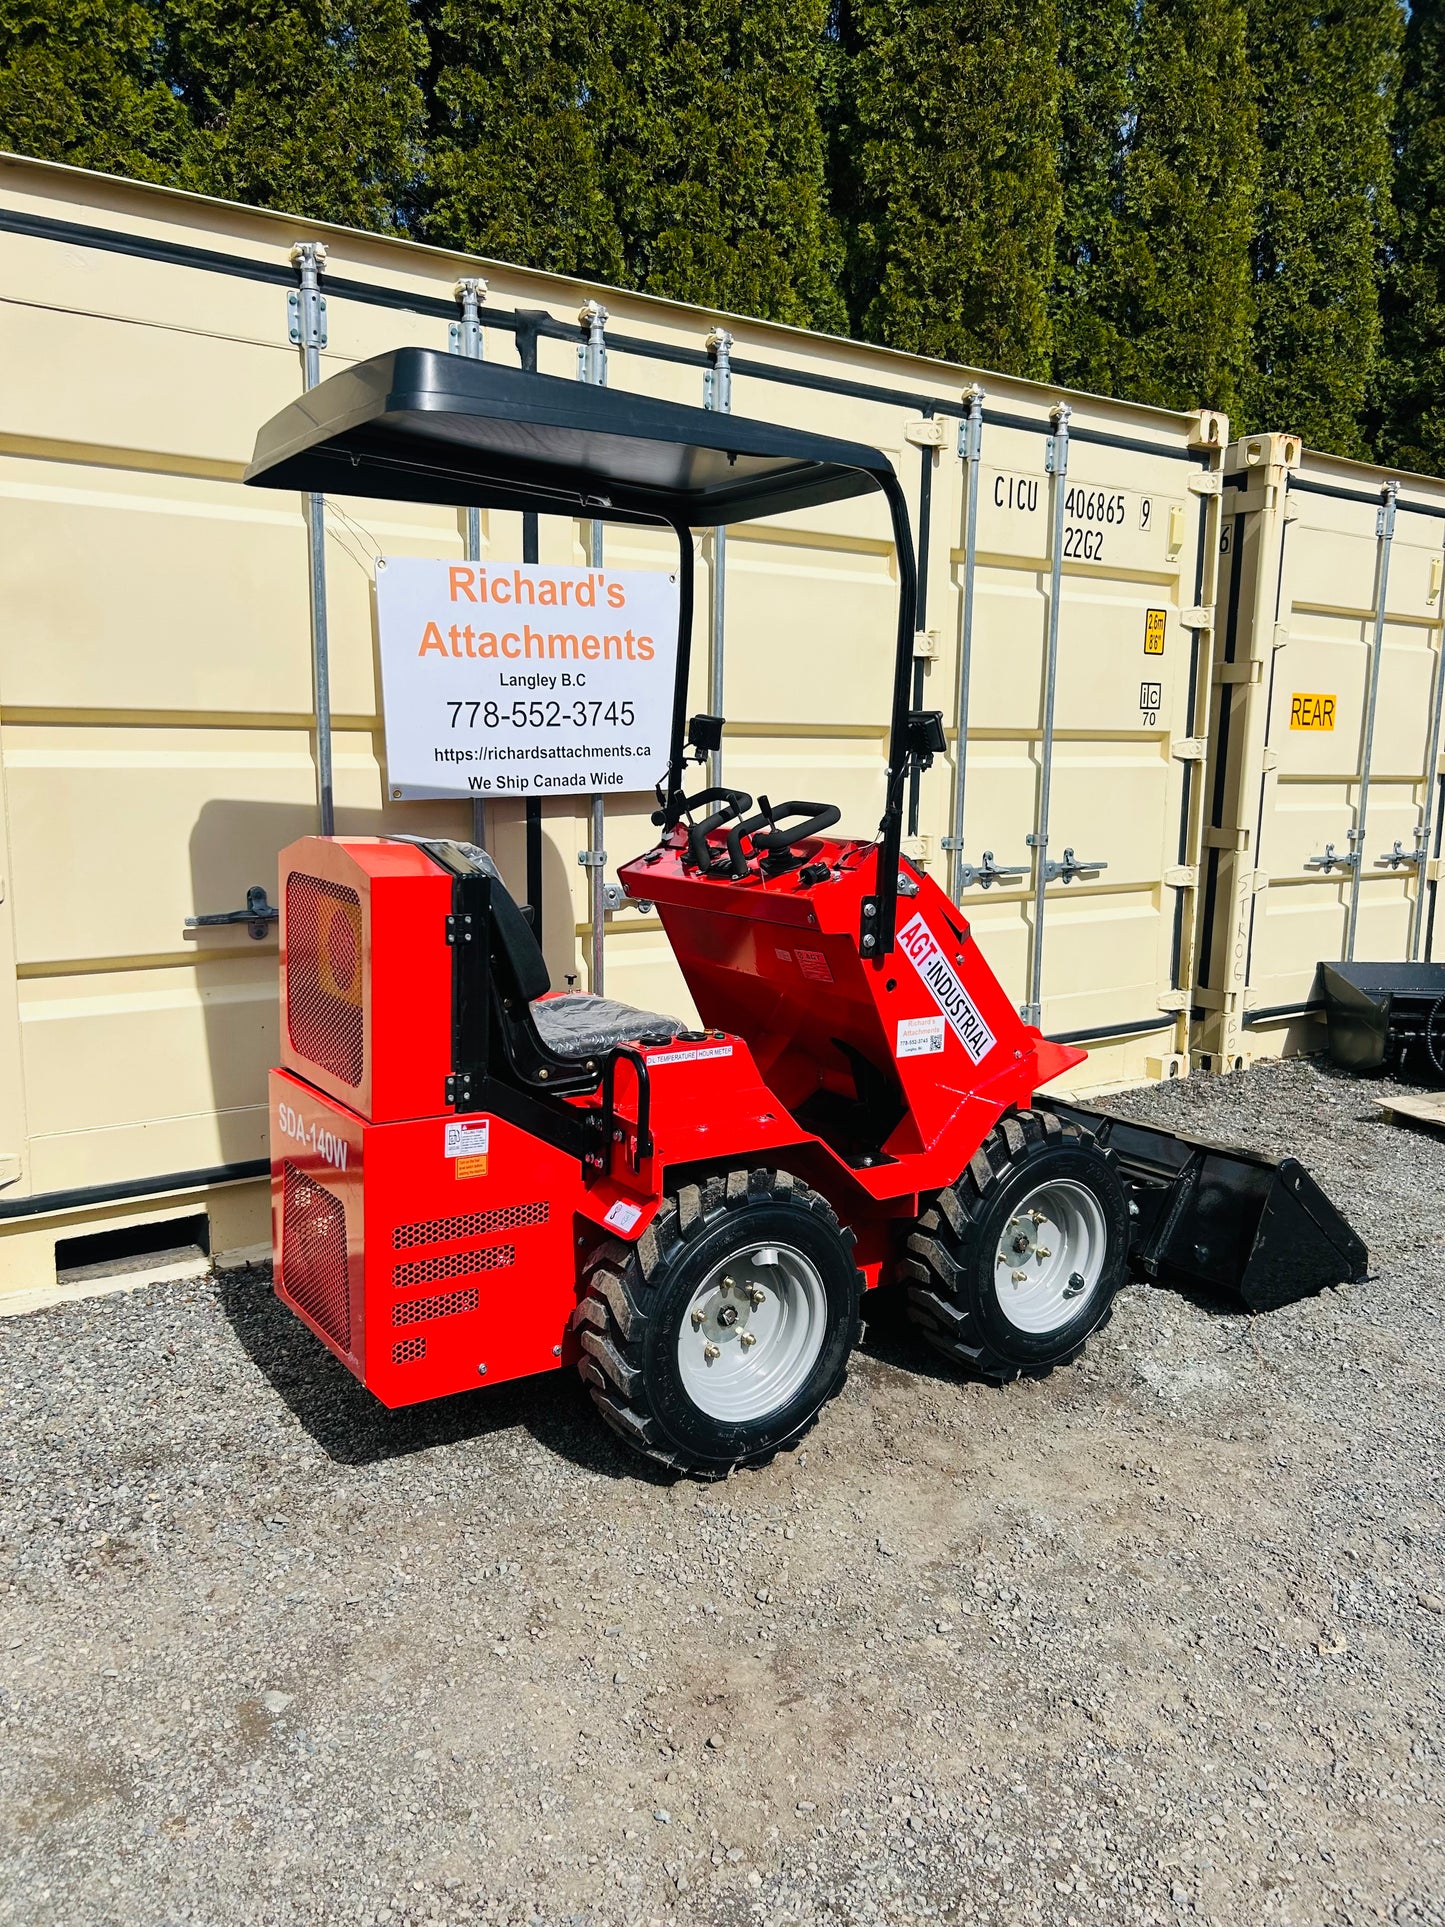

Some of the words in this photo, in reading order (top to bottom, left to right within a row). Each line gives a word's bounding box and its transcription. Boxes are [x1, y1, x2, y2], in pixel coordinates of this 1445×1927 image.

[994, 475, 1038, 512] CICU
[1065, 487, 1125, 525] 406865
[1142, 499, 1151, 528] 9
[1064, 527, 1104, 561] 22G2
[1219, 526, 1229, 552] 6
[449, 566, 626, 609] Richard's
[418, 621, 656, 661] Attachments
[499, 672, 557, 690] Langley
[562, 673, 586, 687] B.C
[447, 700, 635, 728] 778-552-3745
[1142, 711, 1156, 726] 70
[1290, 698, 1335, 727] REAR
[434, 744, 651, 765] https://richardsattachments.ca
[468, 774, 492, 790] We
[496, 774, 529, 791] Ship
[533, 772, 587, 788] Canada
[590, 771, 624, 786] Wide
[900, 922, 938, 967] AGT
[926, 960, 988, 1057] INDUSTRIAL
[657, 1052, 696, 1063] TEMPERATURE
[698, 1050, 714, 1058] HOUR
[714, 1047, 732, 1056] METER
[279, 1102, 348, 1172] SDA-140W
